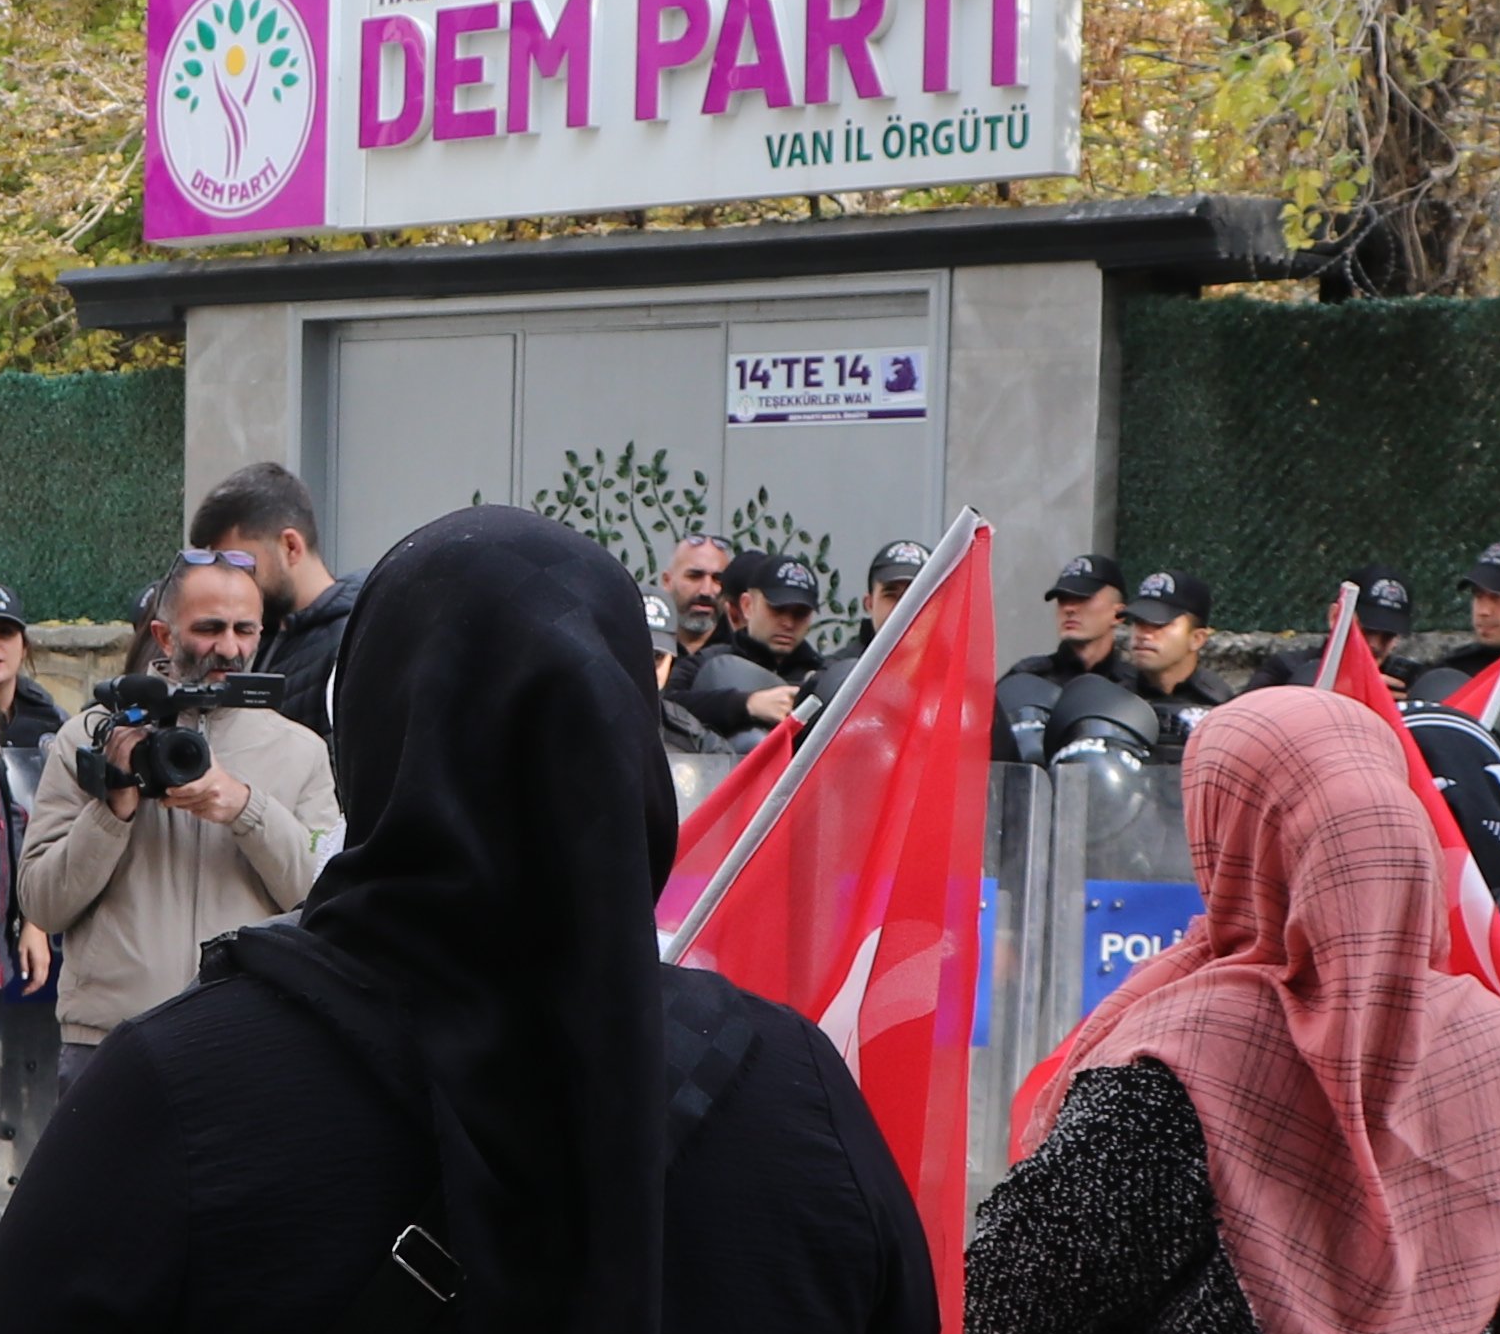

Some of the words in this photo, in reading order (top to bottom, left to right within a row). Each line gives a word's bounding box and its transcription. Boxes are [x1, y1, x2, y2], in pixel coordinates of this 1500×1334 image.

[766, 129, 834, 169] VAN
[844, 119, 873, 163] İL
[882, 103, 1031, 160] ÖRGÜTÜ
[191, 168, 226, 204] DEM
[228, 156, 279, 205] PARTİ
[735, 356, 825, 390] 14'TE
[834, 354, 872, 387] 14
[757, 391, 840, 409] TEŞEKKÜRLER
[843, 392, 872, 405] WAN
